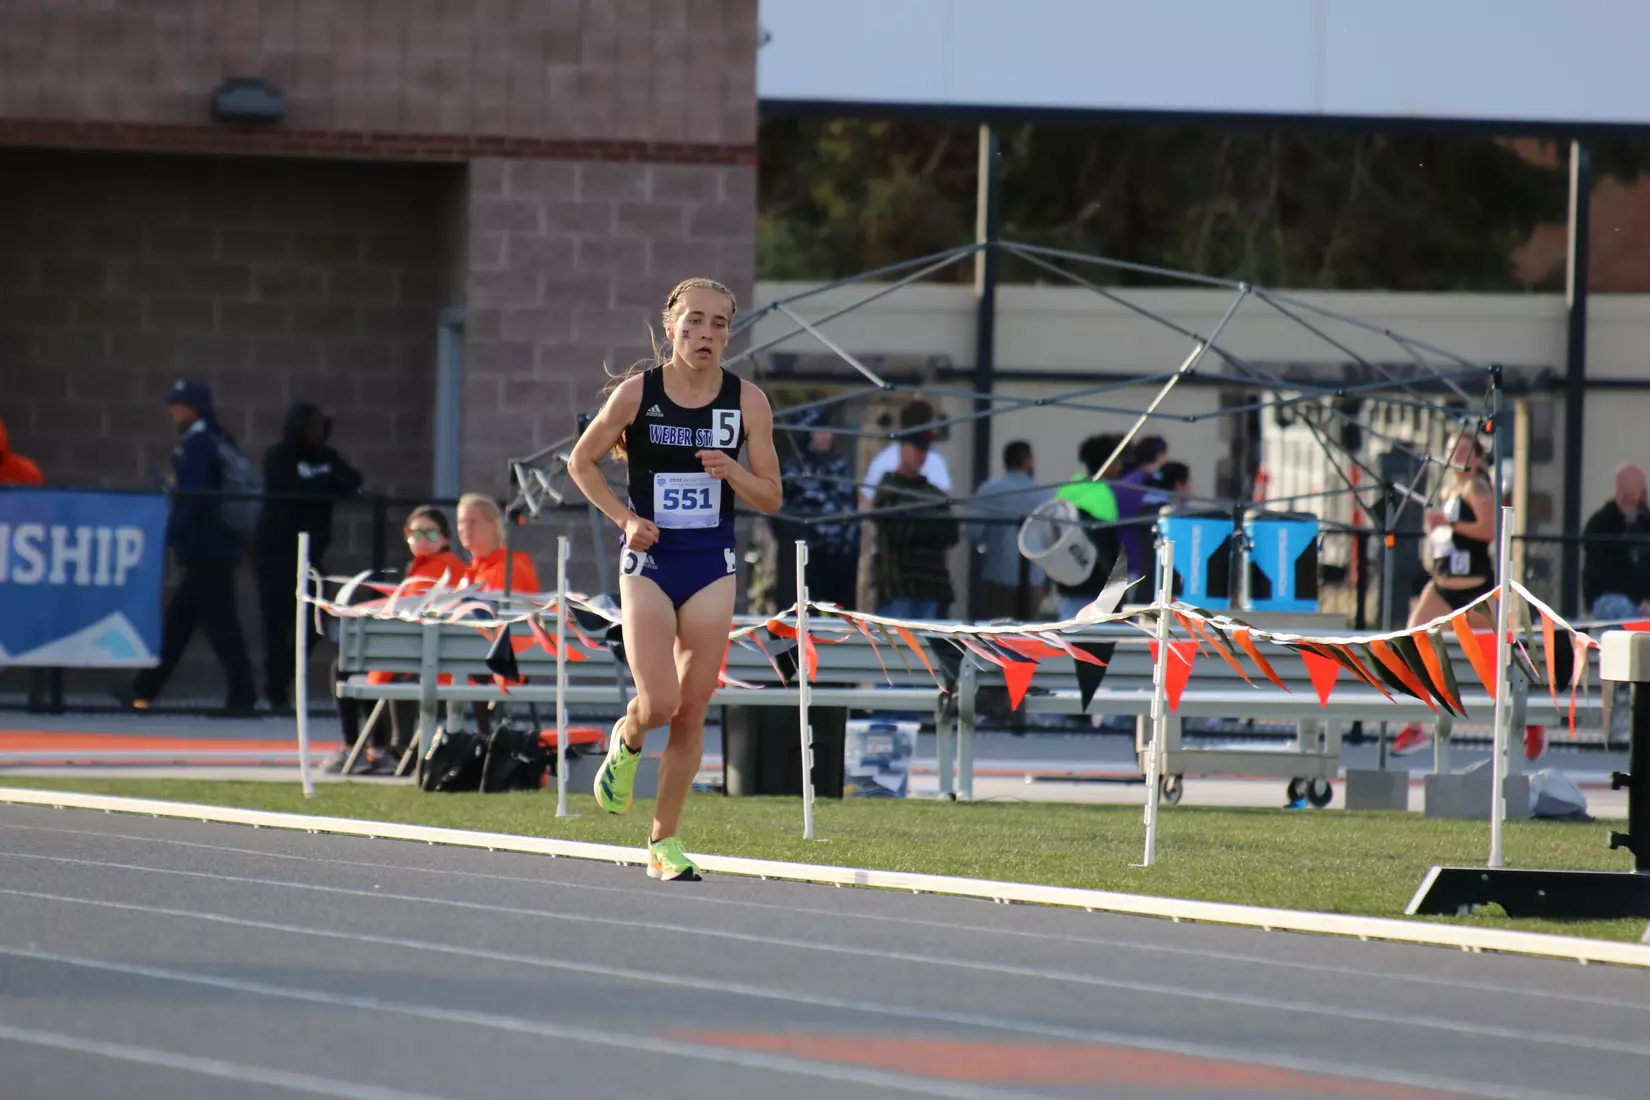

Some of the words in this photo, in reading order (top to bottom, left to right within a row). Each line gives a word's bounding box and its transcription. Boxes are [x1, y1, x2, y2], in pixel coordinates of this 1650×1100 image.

[649, 424, 692, 446] WEBER
[719, 411, 735, 447] 5
[663, 488, 712, 510] 551
